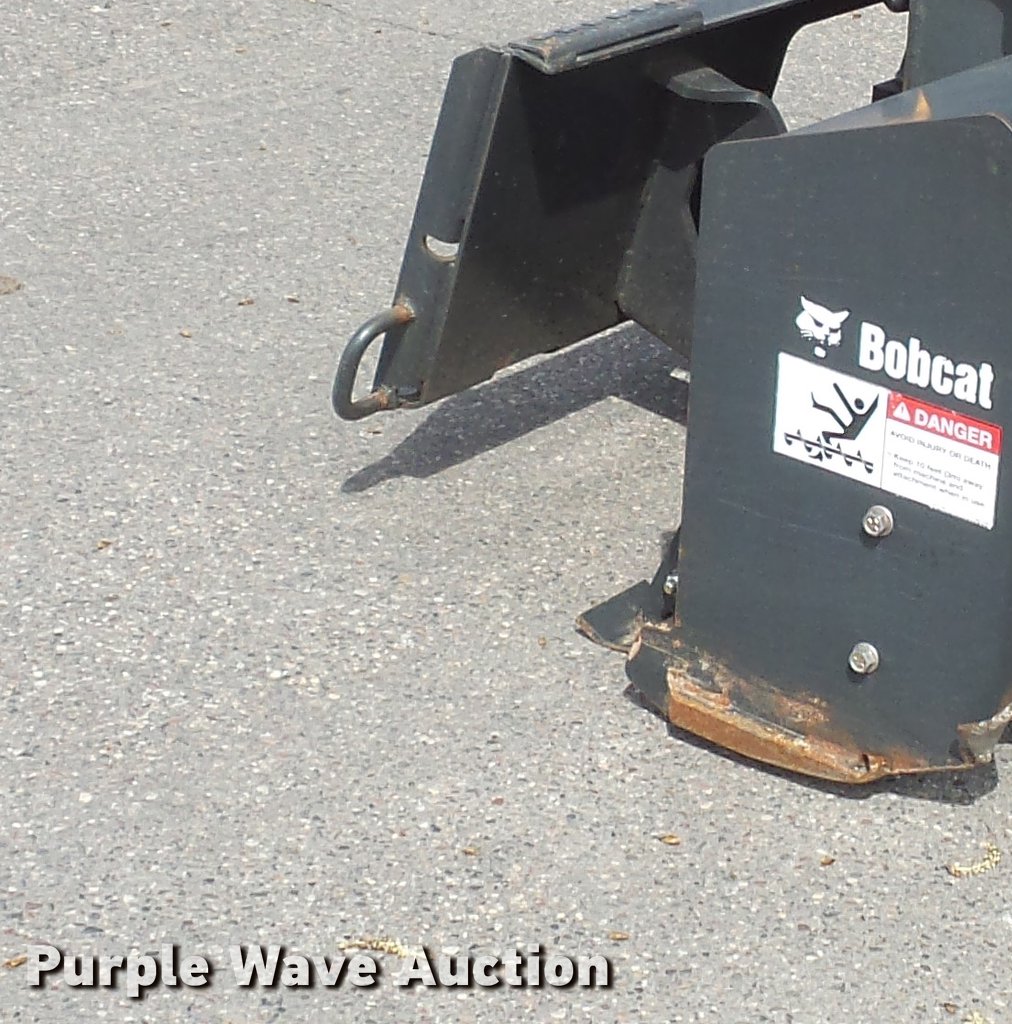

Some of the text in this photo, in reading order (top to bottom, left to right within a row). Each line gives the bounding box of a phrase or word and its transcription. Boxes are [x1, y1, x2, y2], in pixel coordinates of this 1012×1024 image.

[858, 321, 994, 410] Bobcat
[914, 408, 992, 449] DANGER
[890, 430, 991, 470] AVOID INJURY OR DEATH
[893, 453, 913, 465] Keep
[963, 478, 984, 490] away
[893, 461, 964, 491] from machine and
[893, 472, 937, 490] attachment
[939, 488, 960, 498] when
